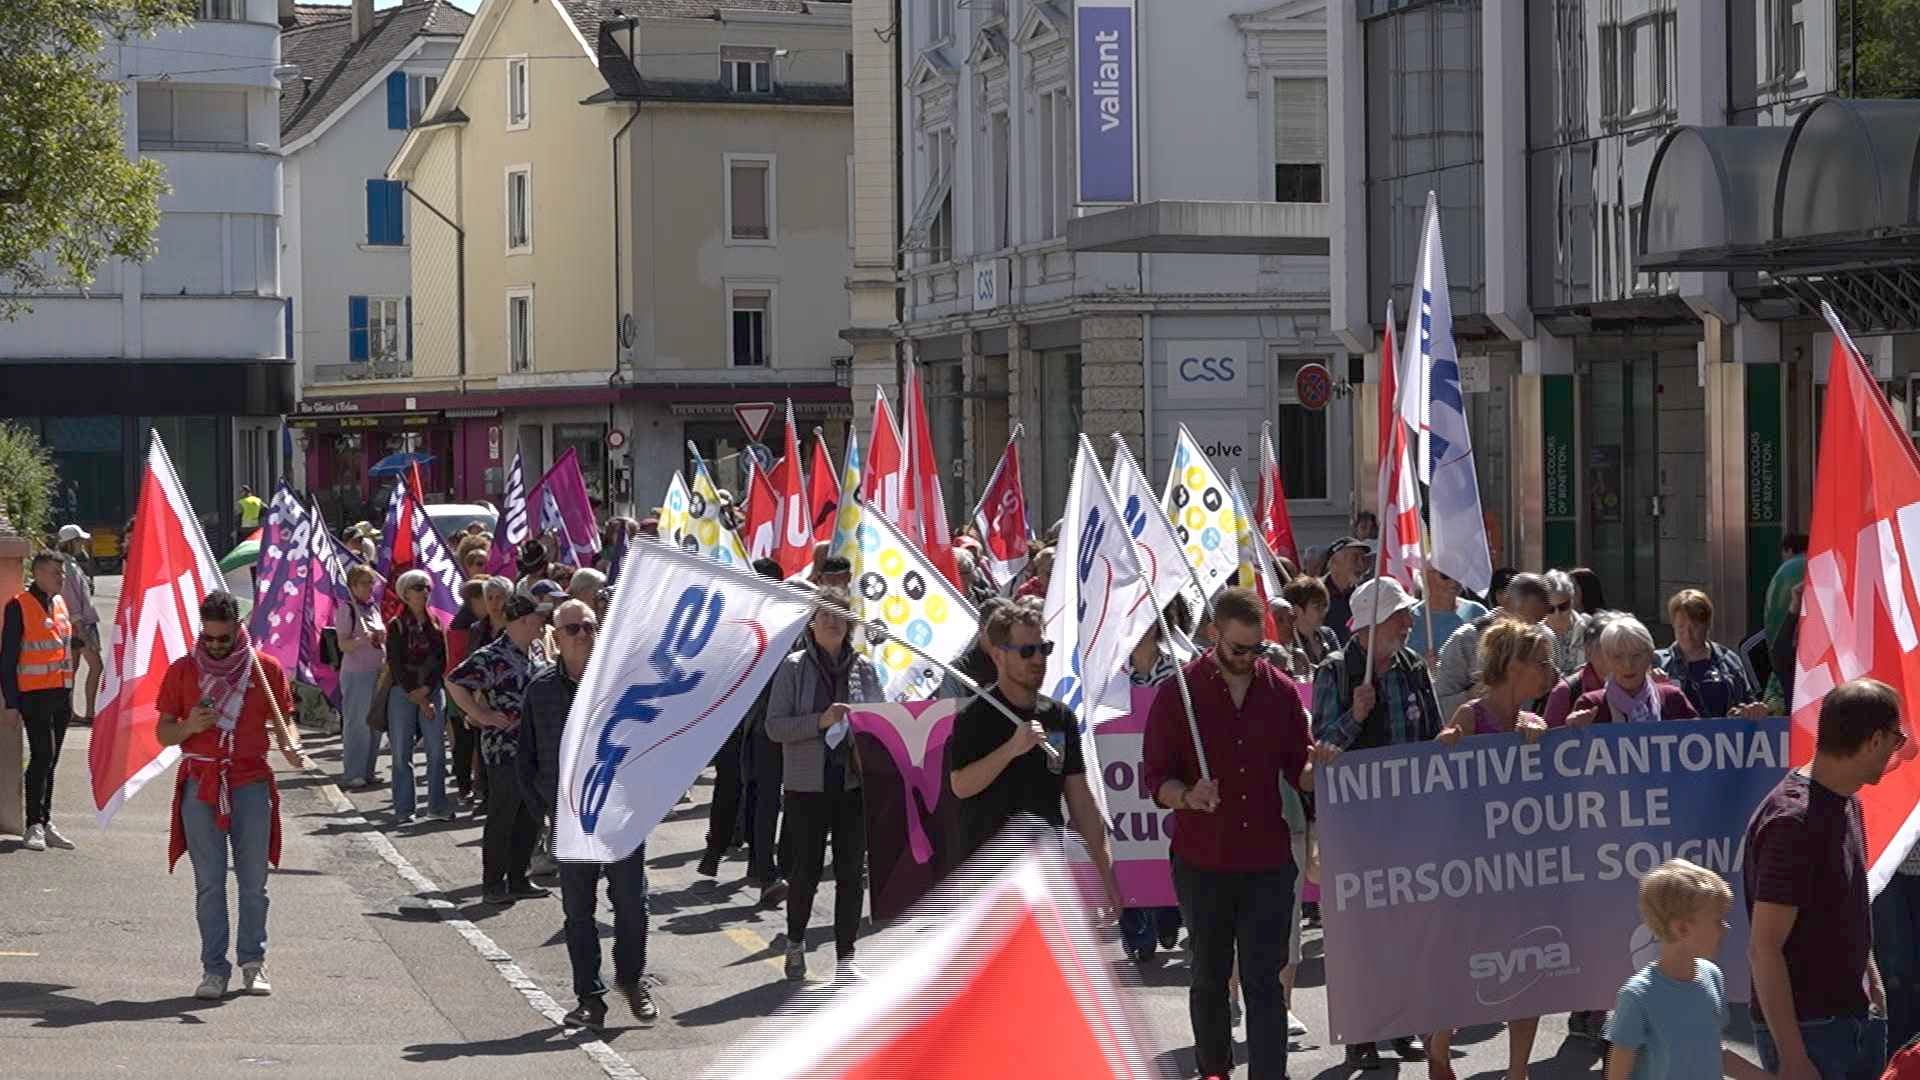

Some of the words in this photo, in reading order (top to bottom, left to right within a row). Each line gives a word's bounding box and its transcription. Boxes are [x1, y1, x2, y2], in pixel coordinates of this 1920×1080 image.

[1093, 30, 1120, 132] valiant
[976, 271, 994, 300] CSS
[1179, 356, 1236, 383] CSS
[1200, 441, 1242, 457] olve
[1326, 743, 1543, 804] INITIATIVE
[1485, 797, 1606, 839] POUR
[1620, 788, 1671, 828] LE
[1334, 845, 1584, 912] PERSONNEL
[1469, 941, 1571, 984] syna
